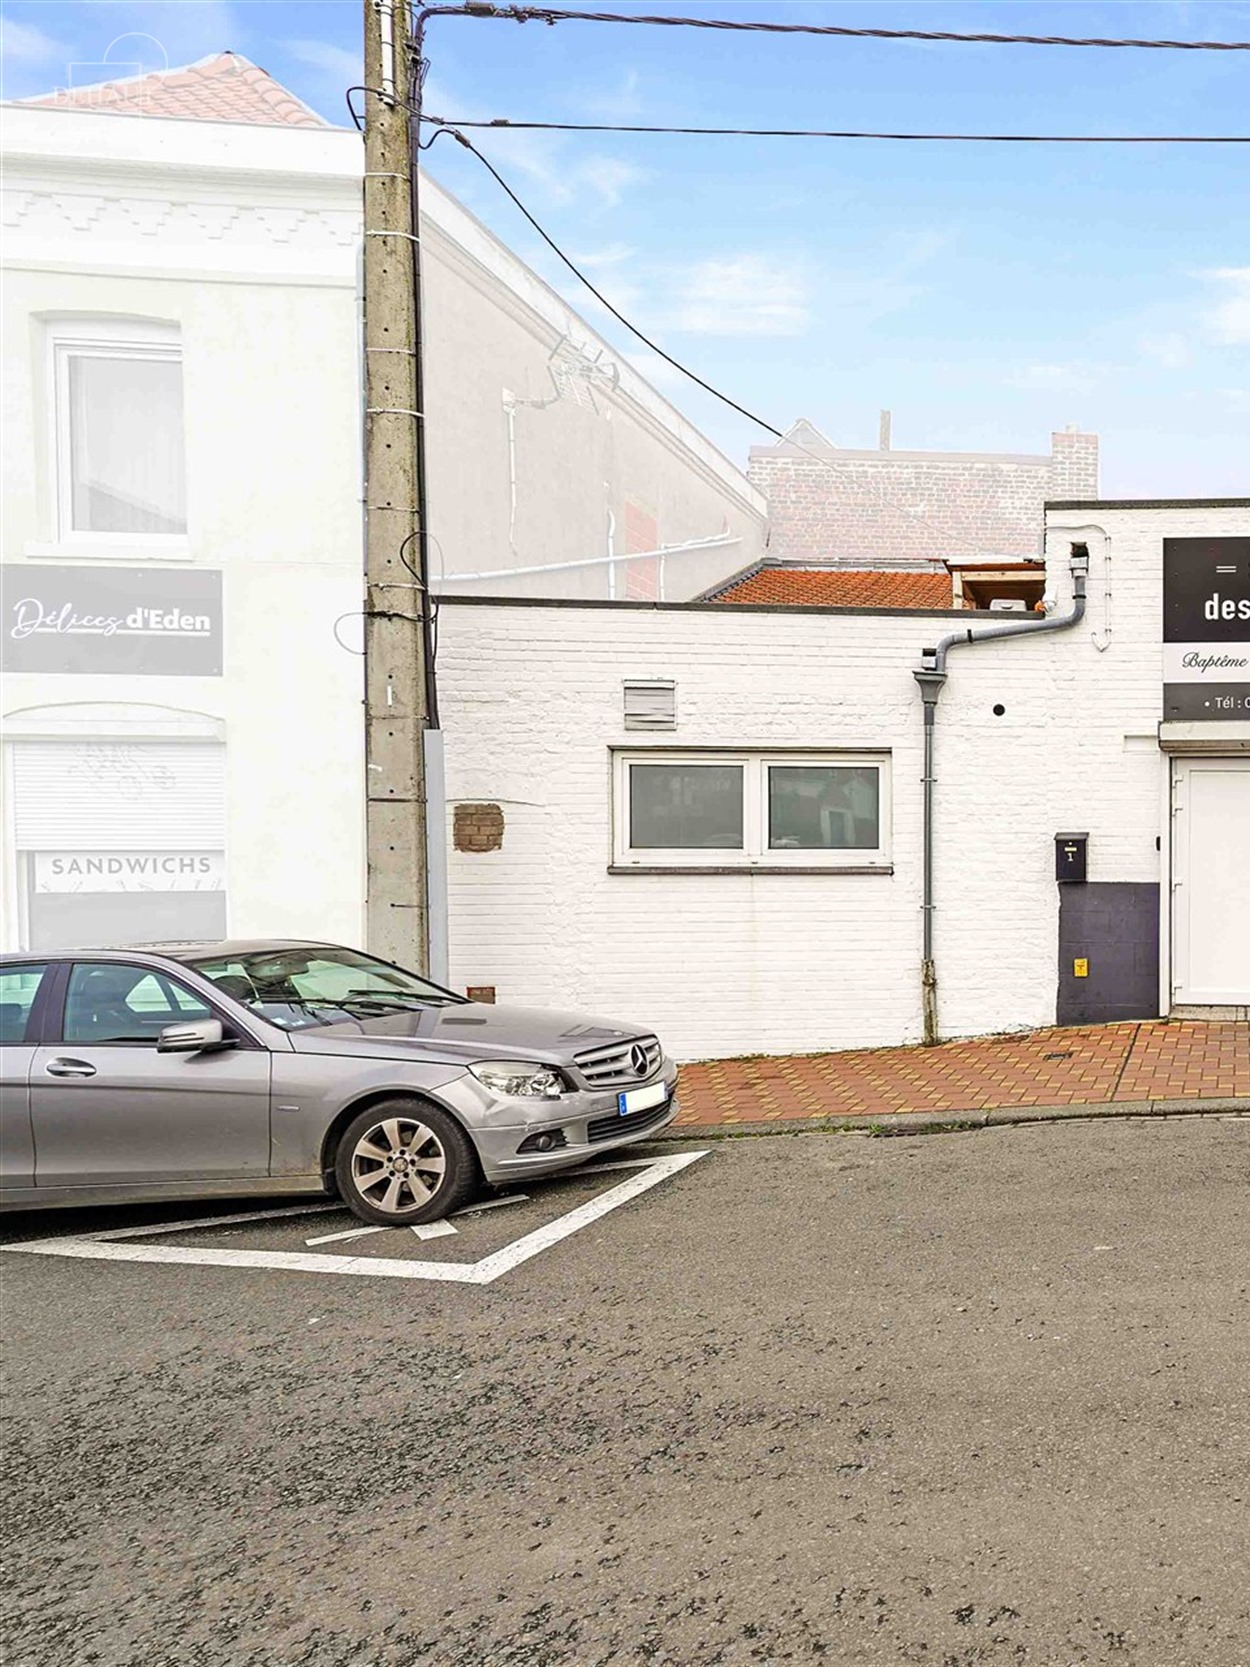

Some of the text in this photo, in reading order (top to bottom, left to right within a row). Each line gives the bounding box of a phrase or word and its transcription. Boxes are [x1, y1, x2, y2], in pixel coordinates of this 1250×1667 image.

[11, 598, 211, 639] Délices d'Eden
[1182, 651, 1249, 673] Baptême
[51, 857, 211, 875] SANDWICHS
[1067, 852, 1074, 862] 1
